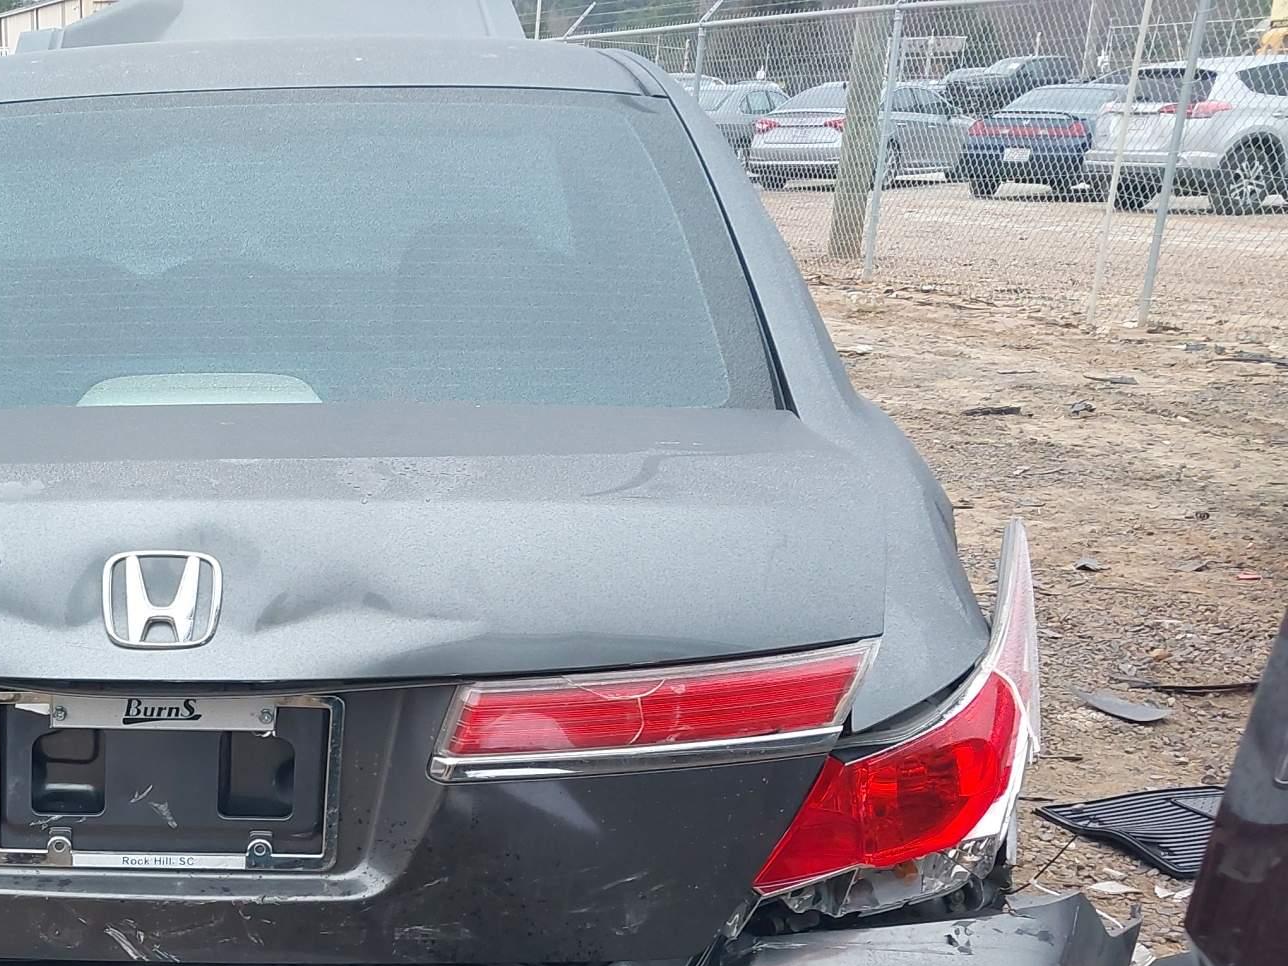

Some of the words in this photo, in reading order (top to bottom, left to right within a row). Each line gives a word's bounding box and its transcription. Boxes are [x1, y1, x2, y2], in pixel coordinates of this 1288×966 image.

[123, 698, 198, 722] BurnS
[122, 856, 149, 866] Rock
[178, 857, 194, 866] SC
